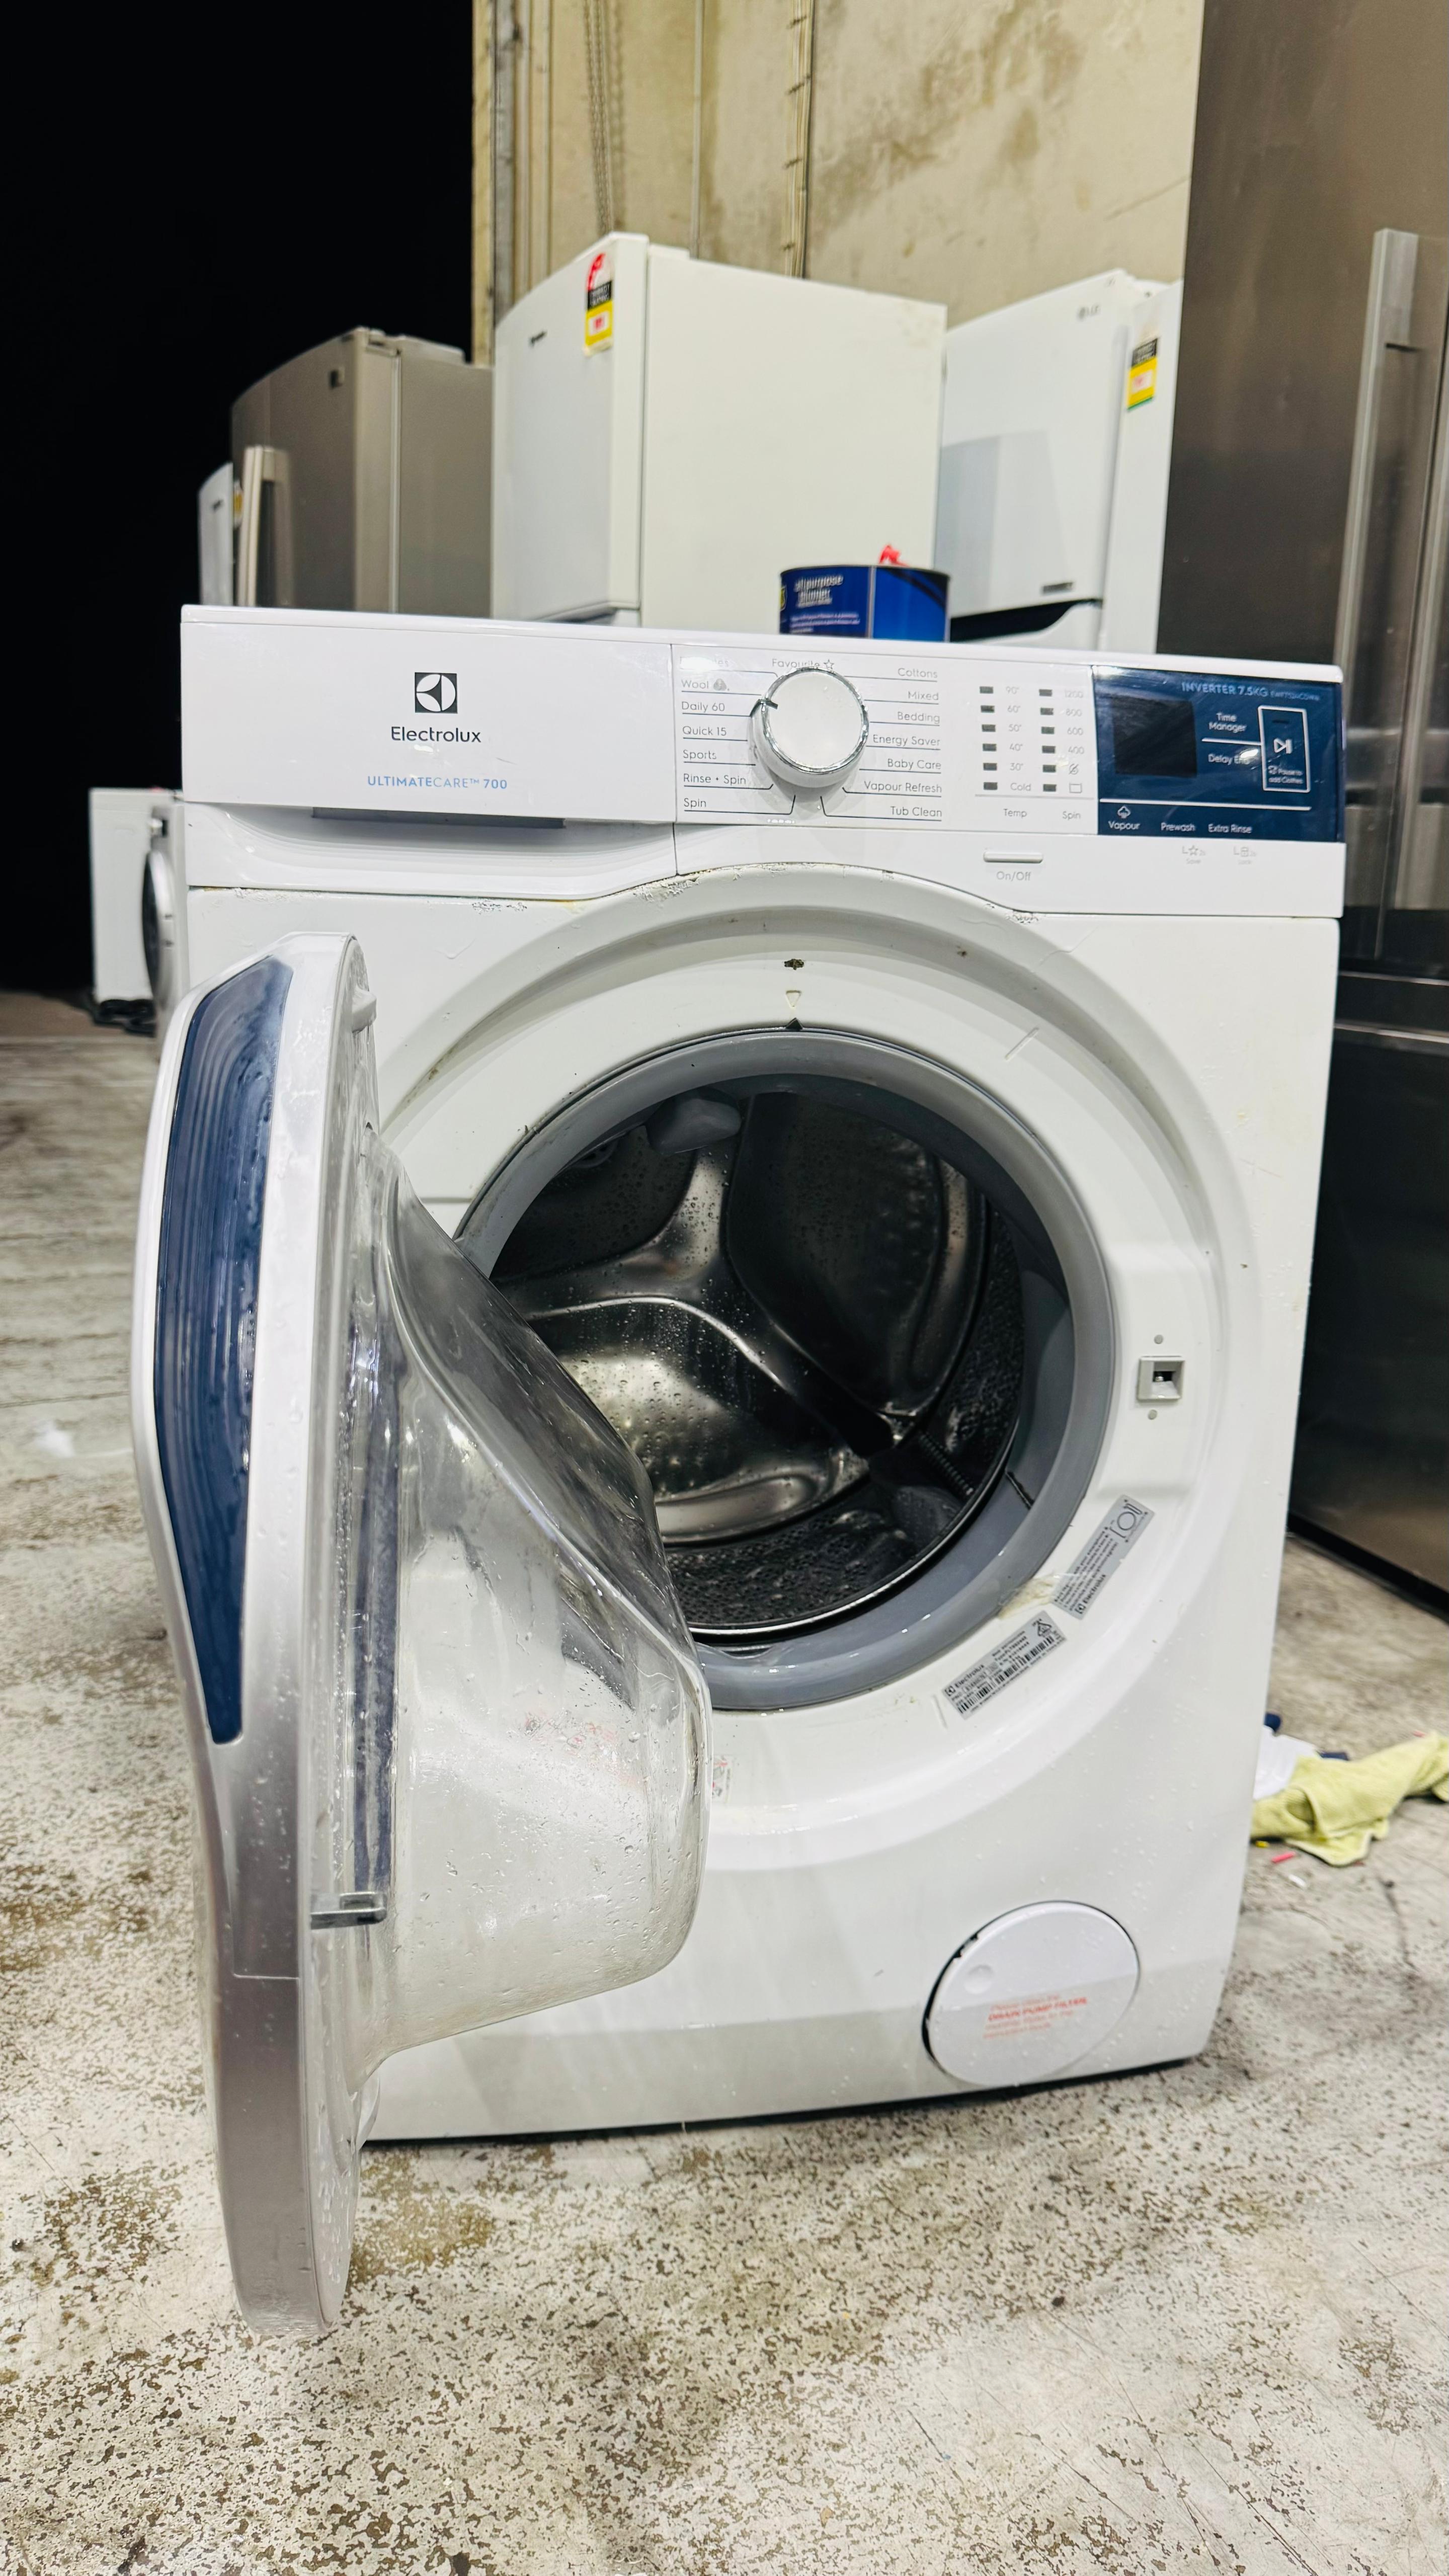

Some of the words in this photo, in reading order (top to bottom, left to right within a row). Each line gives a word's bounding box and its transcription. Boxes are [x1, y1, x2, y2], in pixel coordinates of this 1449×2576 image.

[772, 659, 820, 668] Favourite
[897, 667, 938, 678] Cottons
[681, 679, 709, 689] Wool
[1182, 682, 1237, 694] INVERTER
[1238, 685, 1268, 697] 7.5KG
[908, 691, 939, 701] Mixed
[681, 701, 708, 713] Daily
[711, 702, 725, 712] 60
[897, 711, 940, 724] Bedding
[1216, 712, 1237, 722] Time
[682, 726, 713, 736] Quick
[717, 727, 727, 736] 15
[1209, 722, 1247, 733] Manager
[391, 726, 481, 743] Electrolux
[873, 734, 908, 747] Energy
[911, 736, 940, 746] Saver
[683, 749, 717, 760] Sports
[1208, 754, 1232, 765] Delay
[888, 758, 914, 771] Baby
[917, 760, 941, 770] Care
[483, 779, 507, 789] 700
[683, 773, 711, 783] Rinse
[723, 774, 746, 786] Spin
[863, 780, 902, 792] Vapour
[905, 782, 942, 793] Refresh
[1010, 782, 1031, 791] Cold
[684, 797, 706, 809] Spin
[890, 806, 909, 816] Tub
[912, 807, 942, 817] Clean
[1004, 809, 1027, 818] Temp
[1062, 811, 1081, 820] Spin
[1108, 821, 1141, 830] Vapour
[1161, 822, 1196, 832] Prewash
[1208, 823, 1229, 833] Extra
[1231, 824, 1252, 833] Rinse
[996, 870, 1031, 882] On/Off
